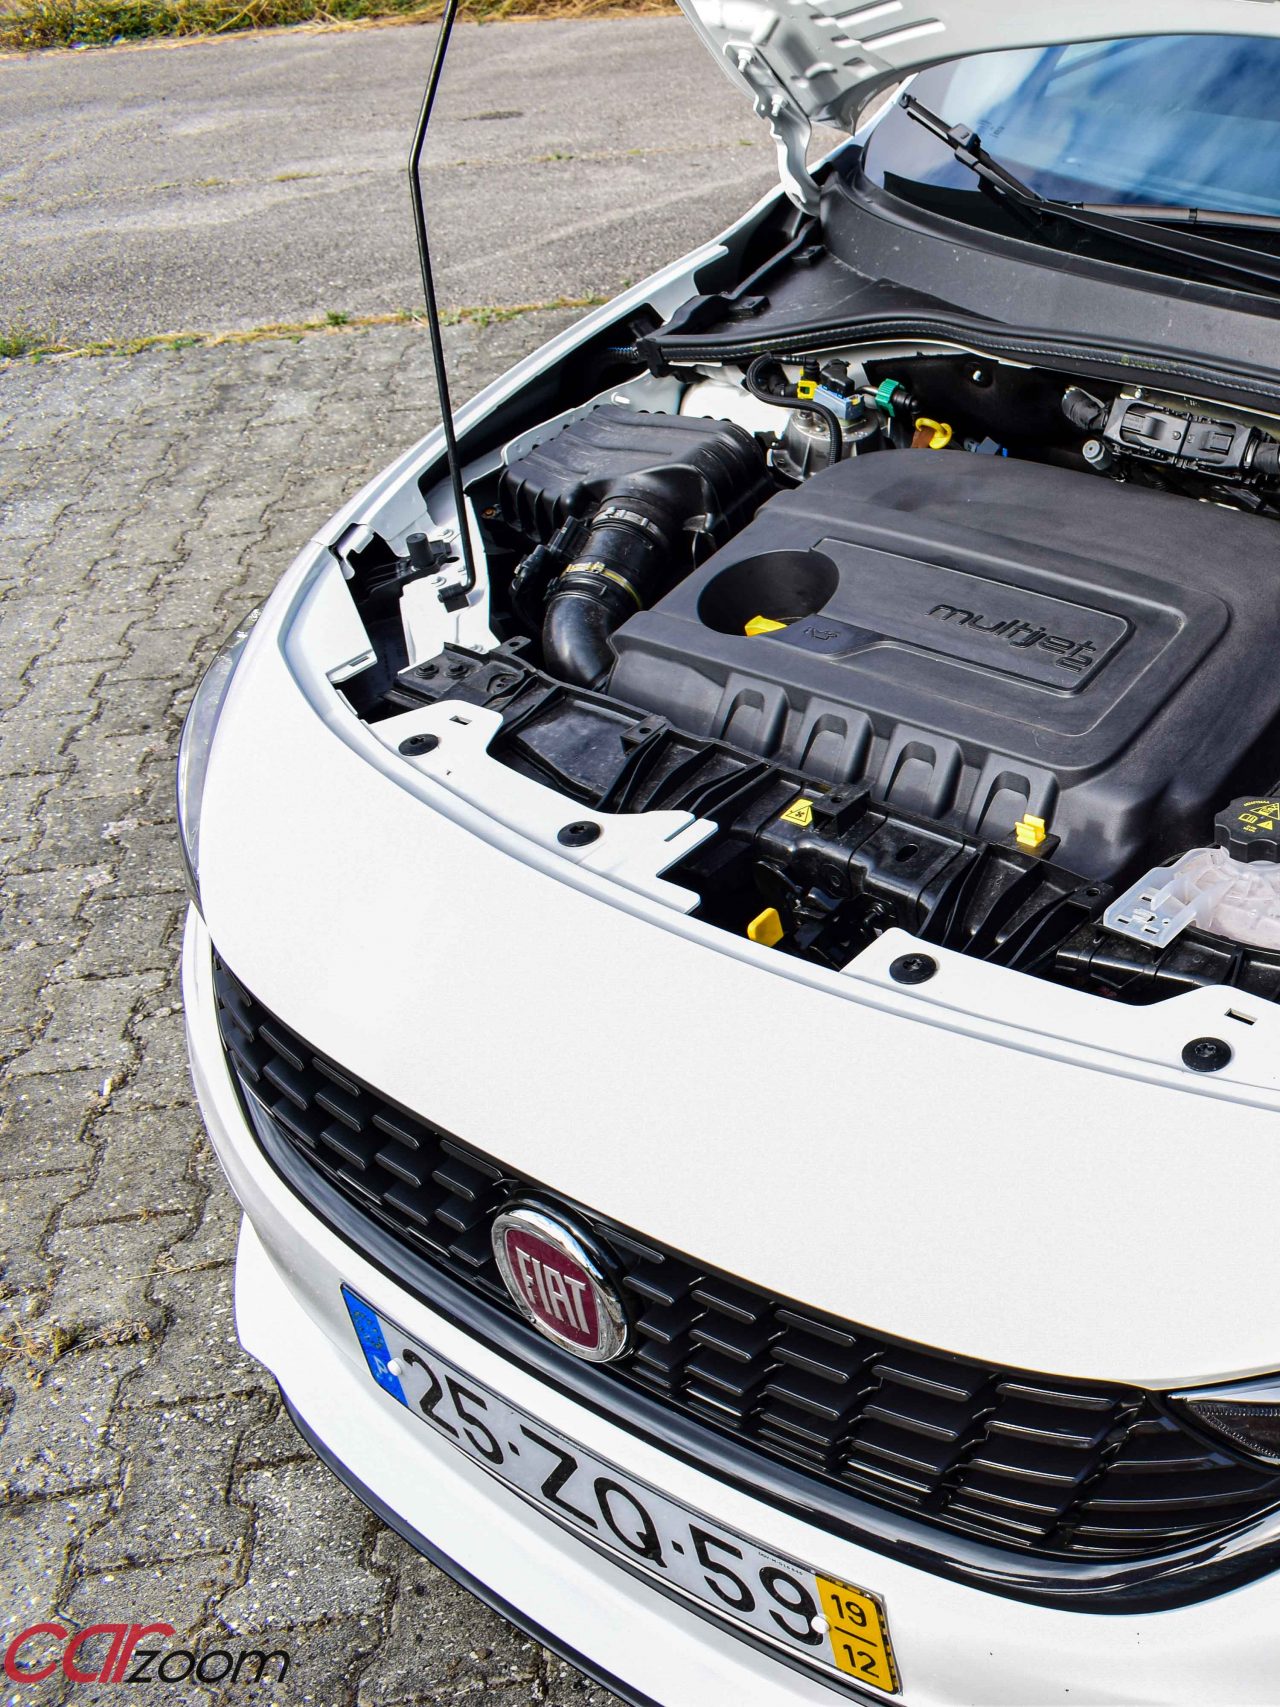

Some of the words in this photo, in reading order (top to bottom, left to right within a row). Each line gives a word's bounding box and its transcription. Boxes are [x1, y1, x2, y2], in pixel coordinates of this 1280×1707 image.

[924, 603, 1097, 658] multijet
[515, 1246, 591, 1335] FIAT
[830, 1594, 867, 1628] 19
[842, 1643, 880, 1679] 12
